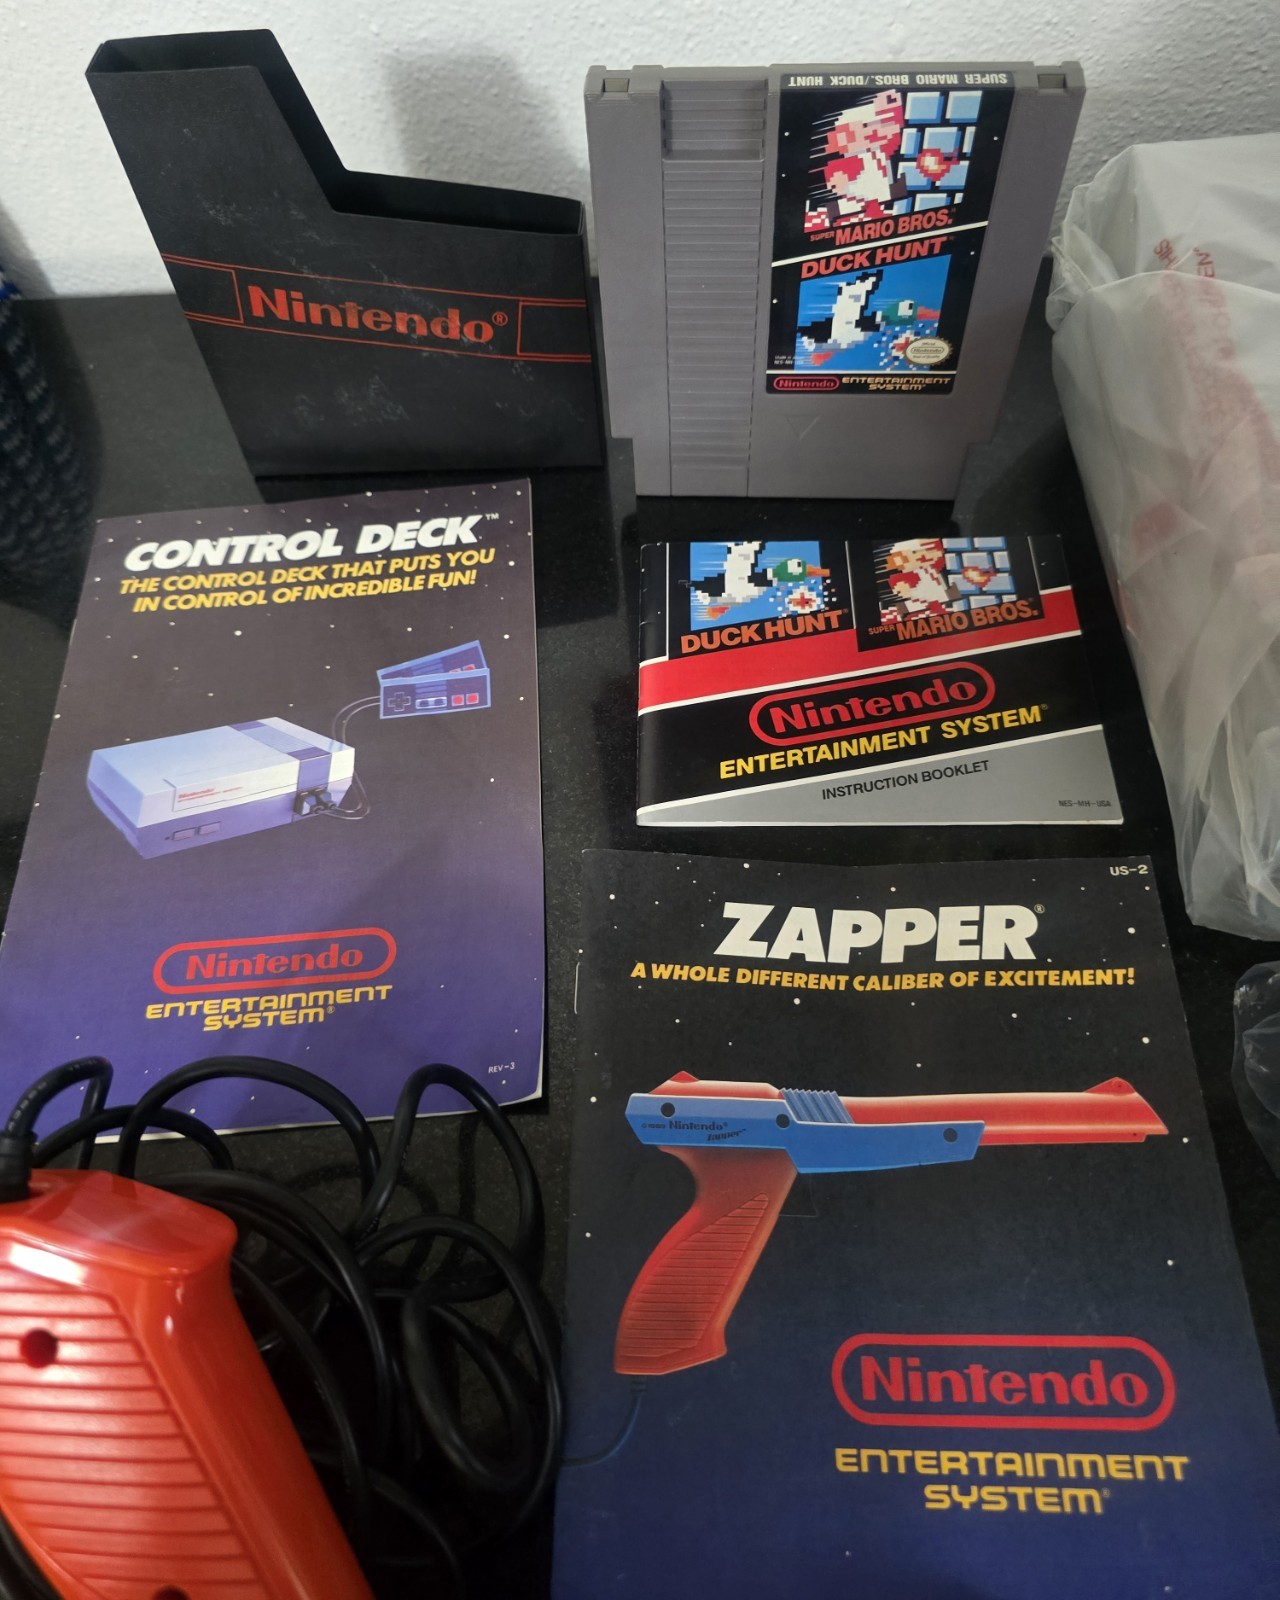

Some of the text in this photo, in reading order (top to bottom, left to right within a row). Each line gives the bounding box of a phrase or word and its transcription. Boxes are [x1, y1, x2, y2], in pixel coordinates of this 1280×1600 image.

[788, 76, 823, 87] HUNT
[916, 74, 958, 85] MARIO
[966, 73, 1007, 84] SUPER
[810, 208, 953, 246] SUPER MARIO BROS.
[801, 236, 949, 279] DUCK HUNT
[779, 377, 951, 389] Nintendo ENTERTAINMENT
[124, 528, 344, 572] CONTROL
[355, 514, 484, 555] DECK
[120, 548, 496, 595] THE CONTROL DECK THAT PUTS YOU
[132, 569, 478, 613] IN CONTROL OF INCREDIBLE FUN!
[681, 609, 843, 654] DUCK HUNT
[868, 600, 1039, 641] SUPER MARIO BROS.
[769, 677, 978, 734] Nintendo
[719, 705, 1042, 780] ENTERTAINMENT SYSTEM
[822, 759, 991, 801] INSTRUCTION BOOKLET
[1110, 864, 1149, 877] US-2
[713, 901, 1039, 964] ZAPPER
[186, 943, 364, 980] Nintendo
[630, 962, 1136, 992] A WHOLE DIFFERENT CALIBER OF EXCITEMENT!
[145, 985, 393, 1020] ENTERTAINMENT
[203, 1006, 325, 1031] SYSTEM
[488, 1061, 516, 1075] REV-3
[669, 1120, 723, 1130] Nintendo
[860, 1355, 1149, 1408] Nintendo
[835, 1447, 1190, 1482] ENTERTAINMENT
[924, 1484, 1104, 1515] SYSTEM
